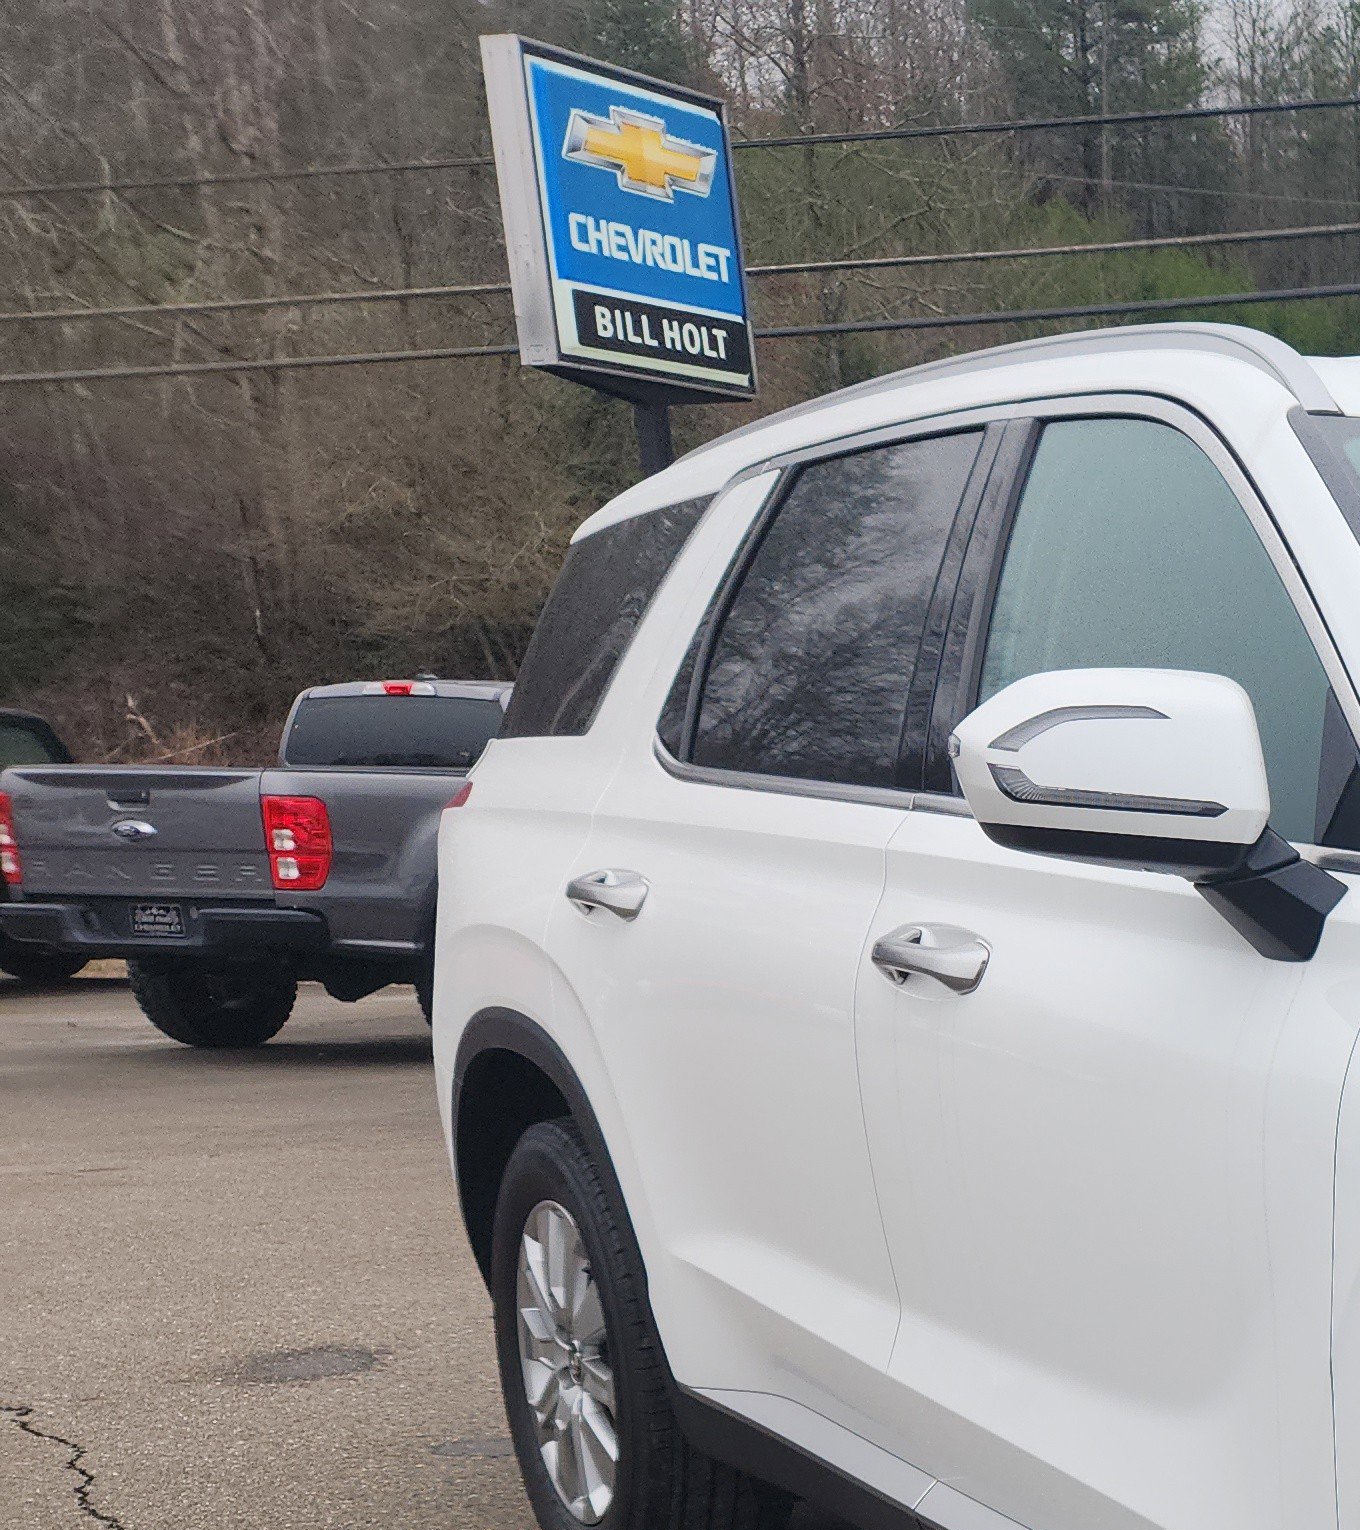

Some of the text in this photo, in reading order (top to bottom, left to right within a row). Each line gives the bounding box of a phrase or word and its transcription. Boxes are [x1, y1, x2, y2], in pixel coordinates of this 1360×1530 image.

[568, 212, 731, 283] CHEVROLET
[594, 305, 728, 360] BILL HOLT
[31, 859, 264, 882] RANGER
